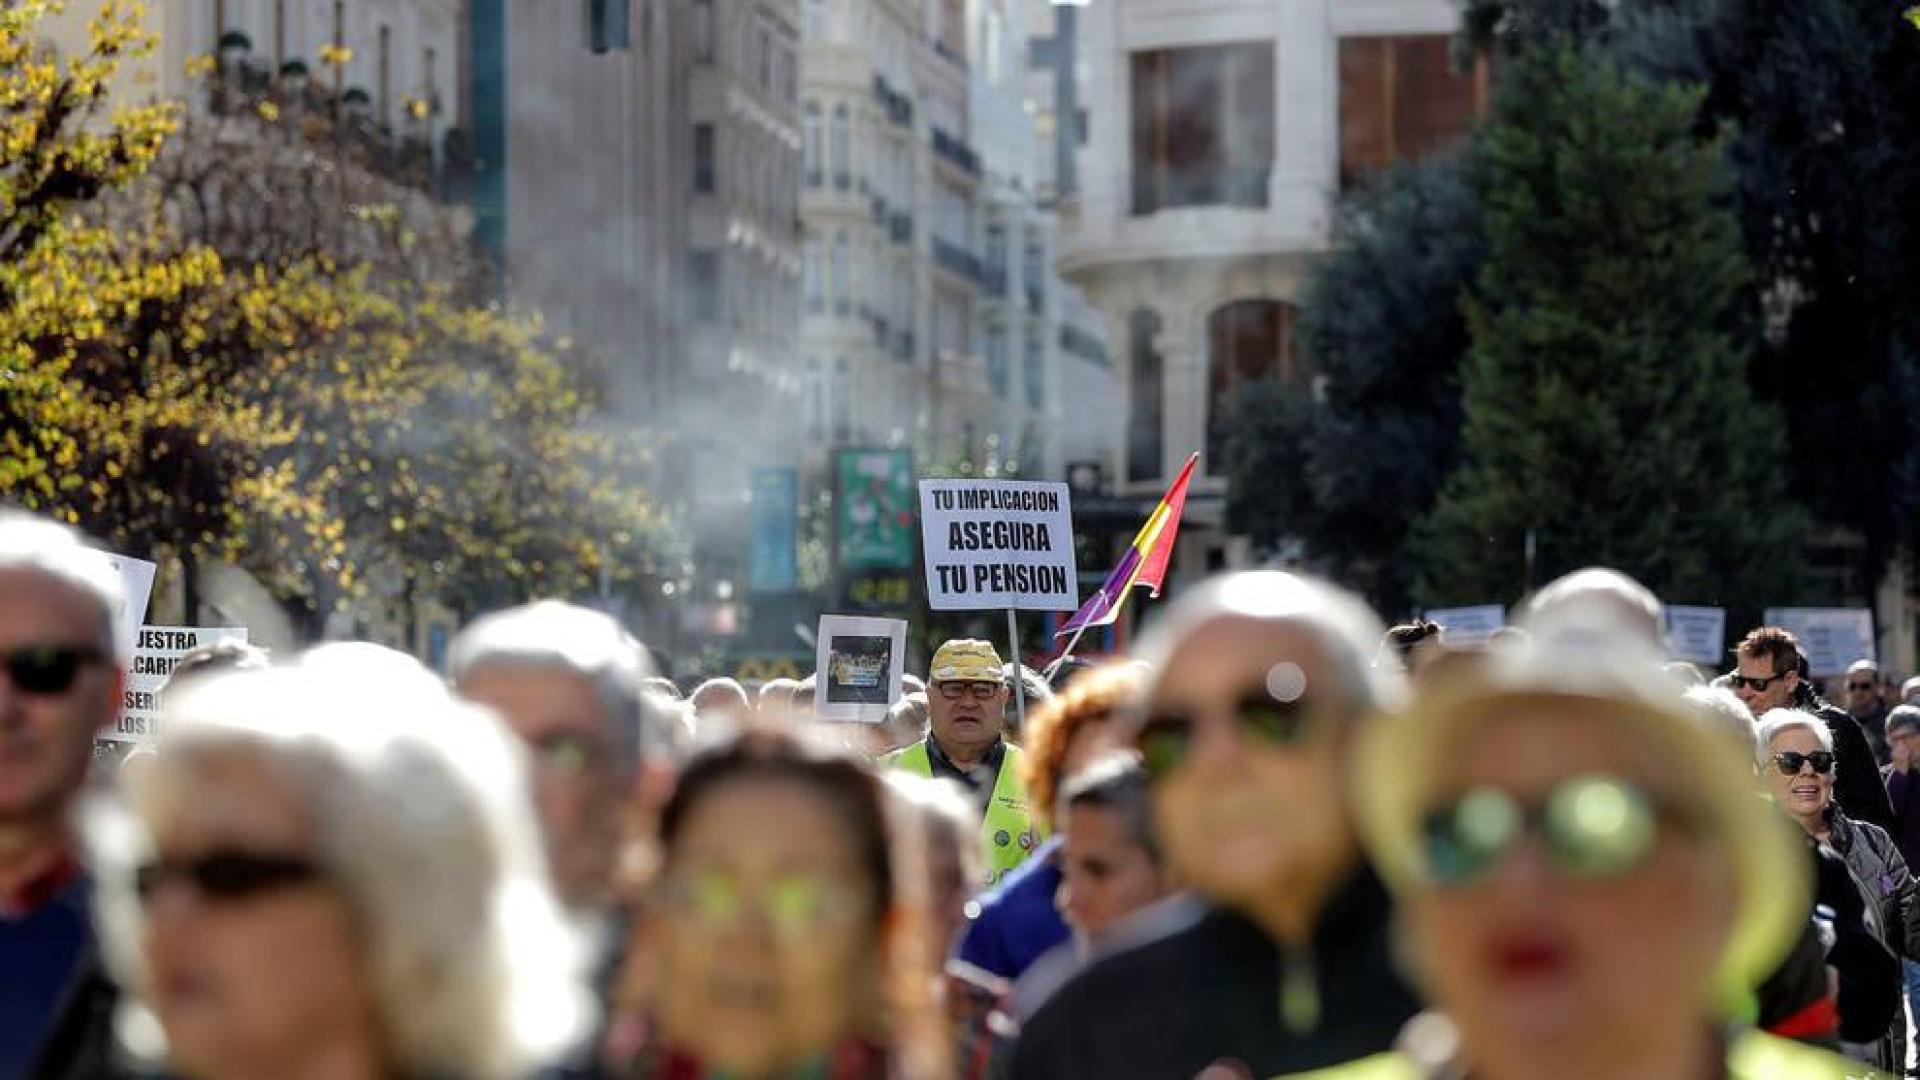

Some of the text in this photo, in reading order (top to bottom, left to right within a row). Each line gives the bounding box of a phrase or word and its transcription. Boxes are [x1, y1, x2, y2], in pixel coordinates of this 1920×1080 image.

[932, 489, 1060, 513] TU IMPLICACION
[948, 521, 1052, 551] ASEGURA
[935, 565, 967, 594] TU
[973, 564, 1068, 594] PENSION
